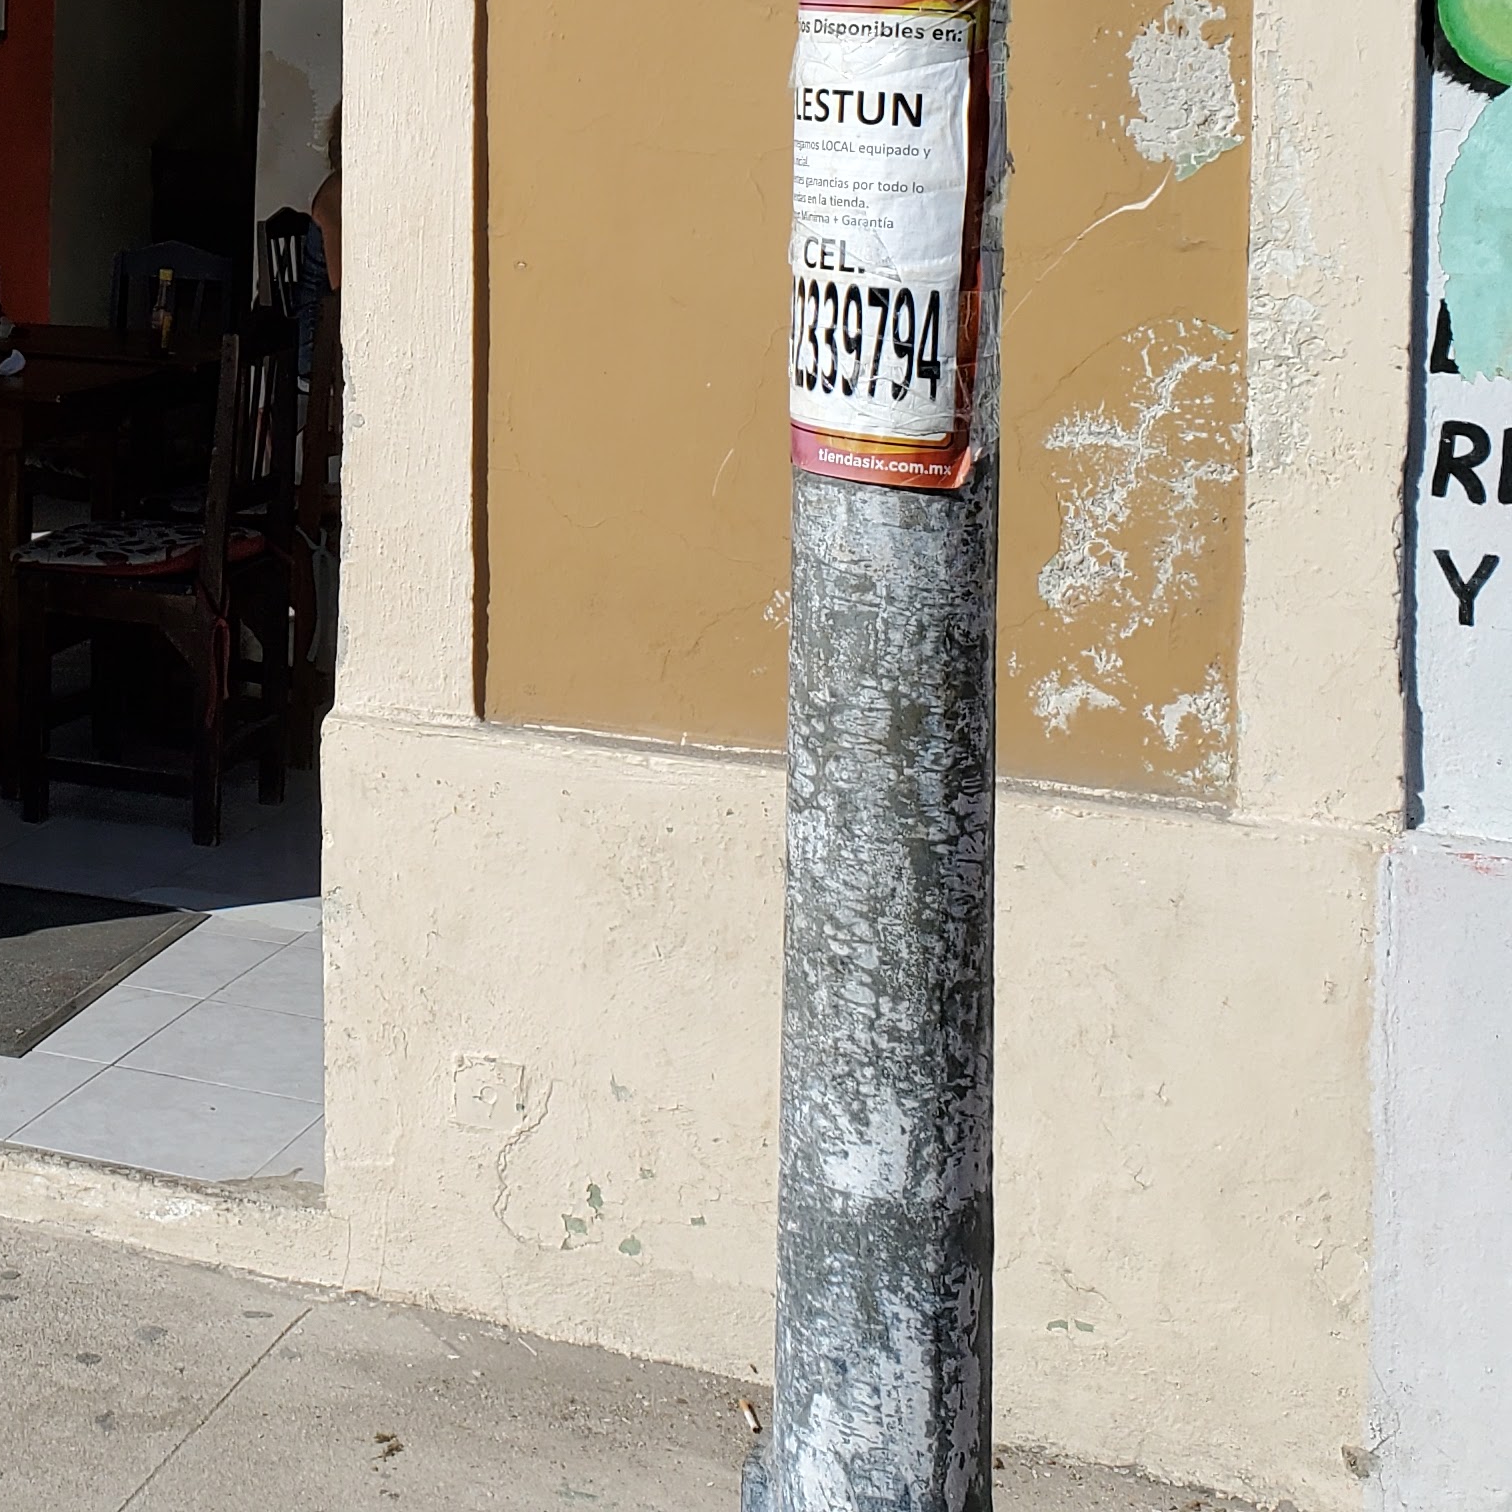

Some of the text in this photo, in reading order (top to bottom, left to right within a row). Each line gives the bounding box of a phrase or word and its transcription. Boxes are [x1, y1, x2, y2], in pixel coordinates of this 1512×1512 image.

[813, 18, 925, 40] Disponibles
[822, 139, 856, 153] LOCAL
[859, 142, 920, 158] equipado
[923, 147, 931, 159] y
[852, 179, 874, 192] por
[878, 181, 908, 193] todo
[912, 181, 924, 194] lo
[830, 194, 870, 209] tienda.
[842, 215, 894, 229] Garantía
[803, 238, 866, 274] CEL.
[818, 448, 952, 476] tiendasix.com.mx
[1433, 549, 1500, 626] Y
